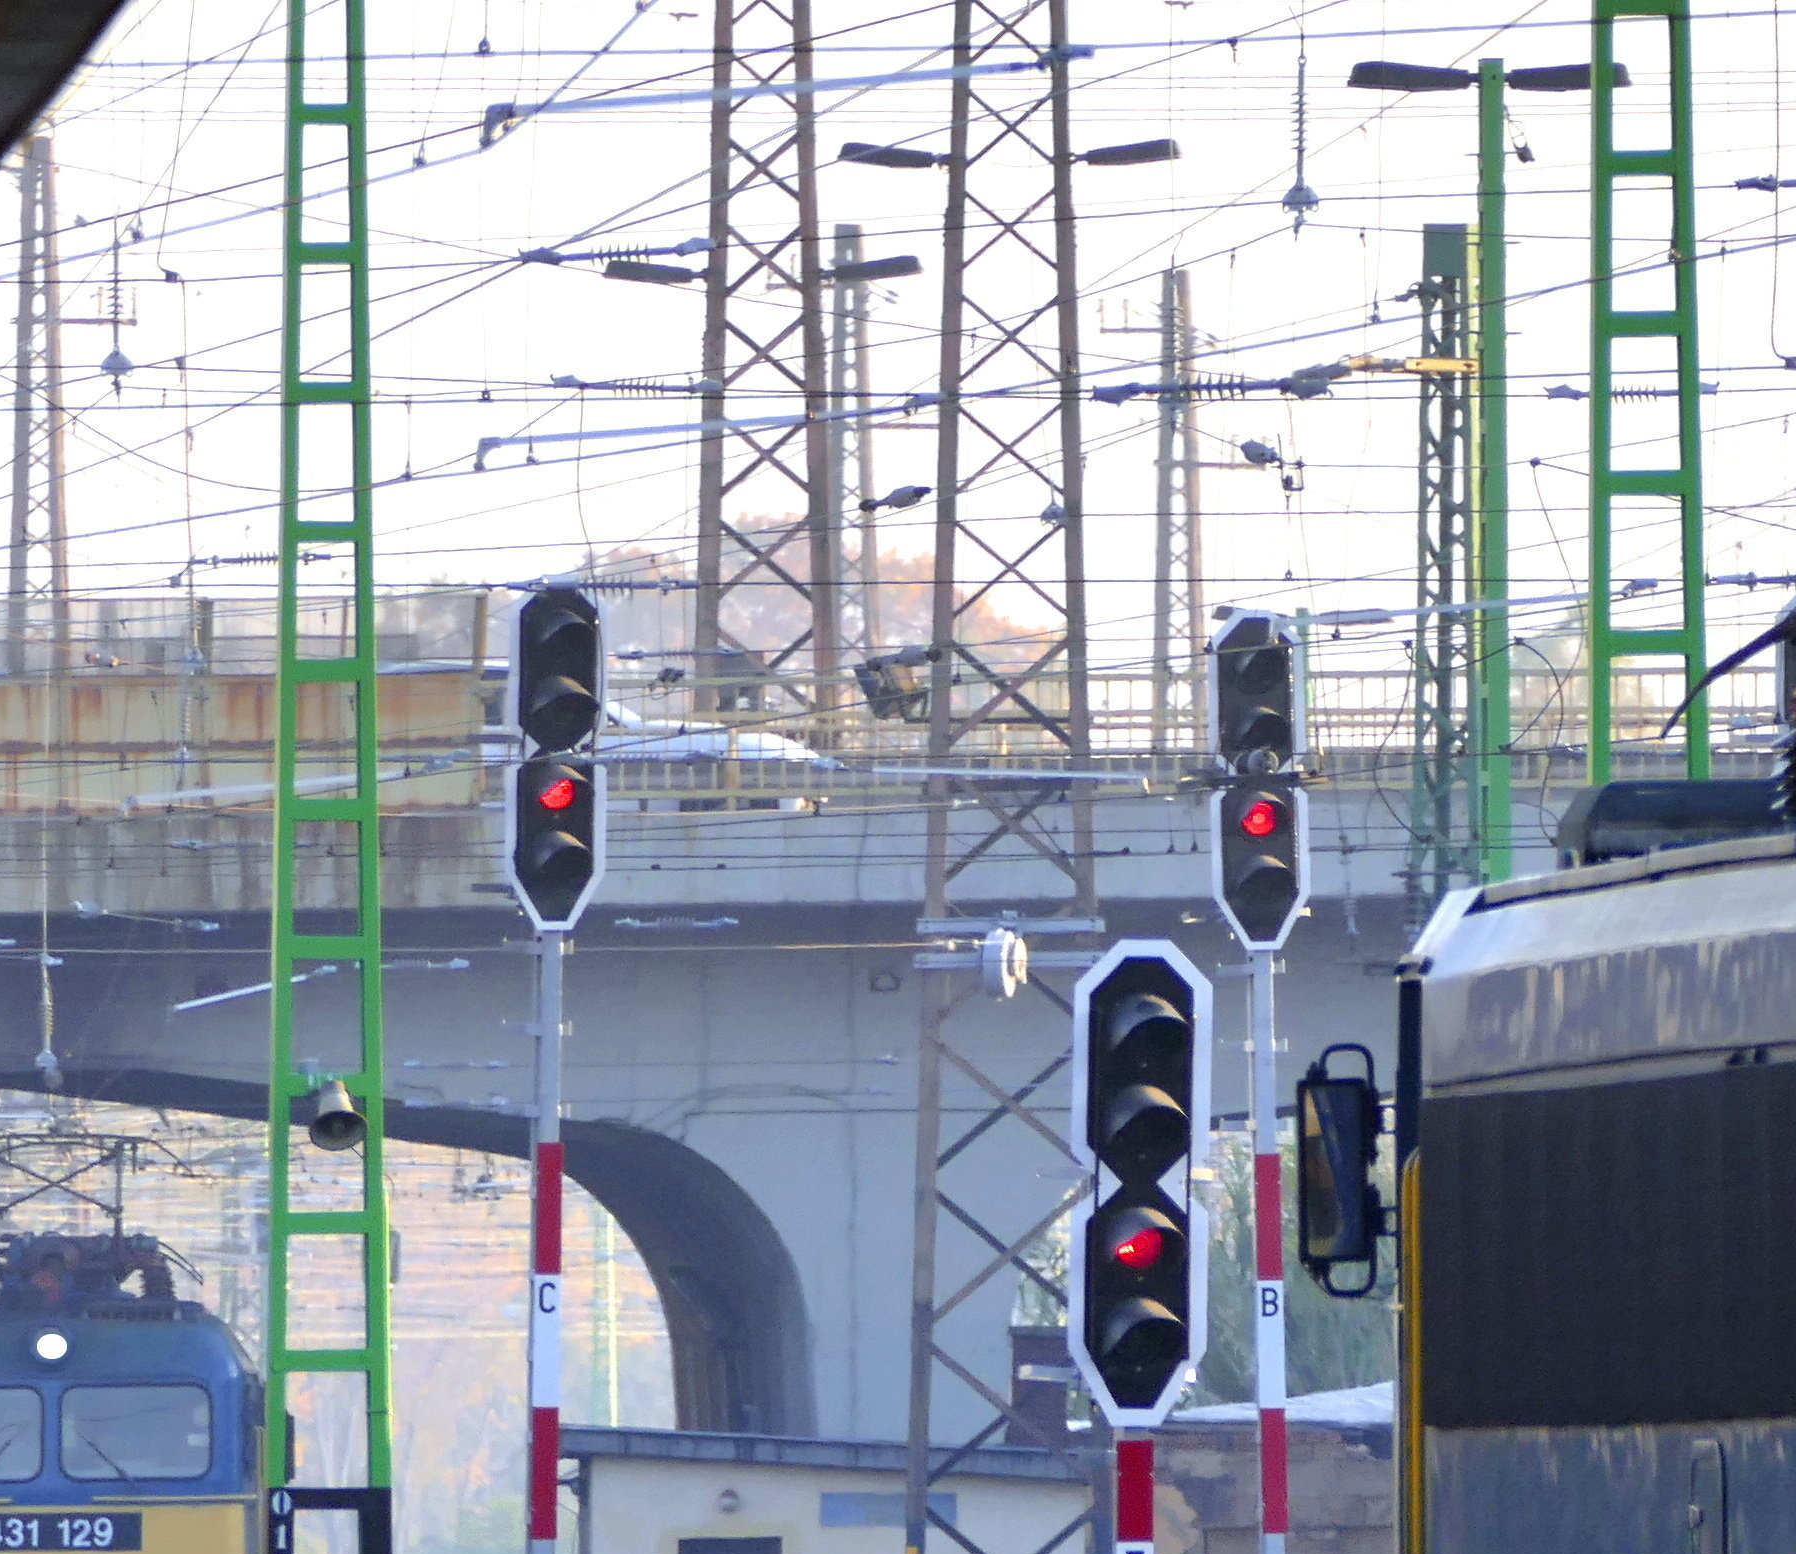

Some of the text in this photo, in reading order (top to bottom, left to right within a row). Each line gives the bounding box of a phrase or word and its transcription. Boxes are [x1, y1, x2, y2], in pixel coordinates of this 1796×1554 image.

[538, 1281, 557, 1314] C
[1261, 1286, 1279, 1318] B
[57, 1516, 115, 1548] 129
